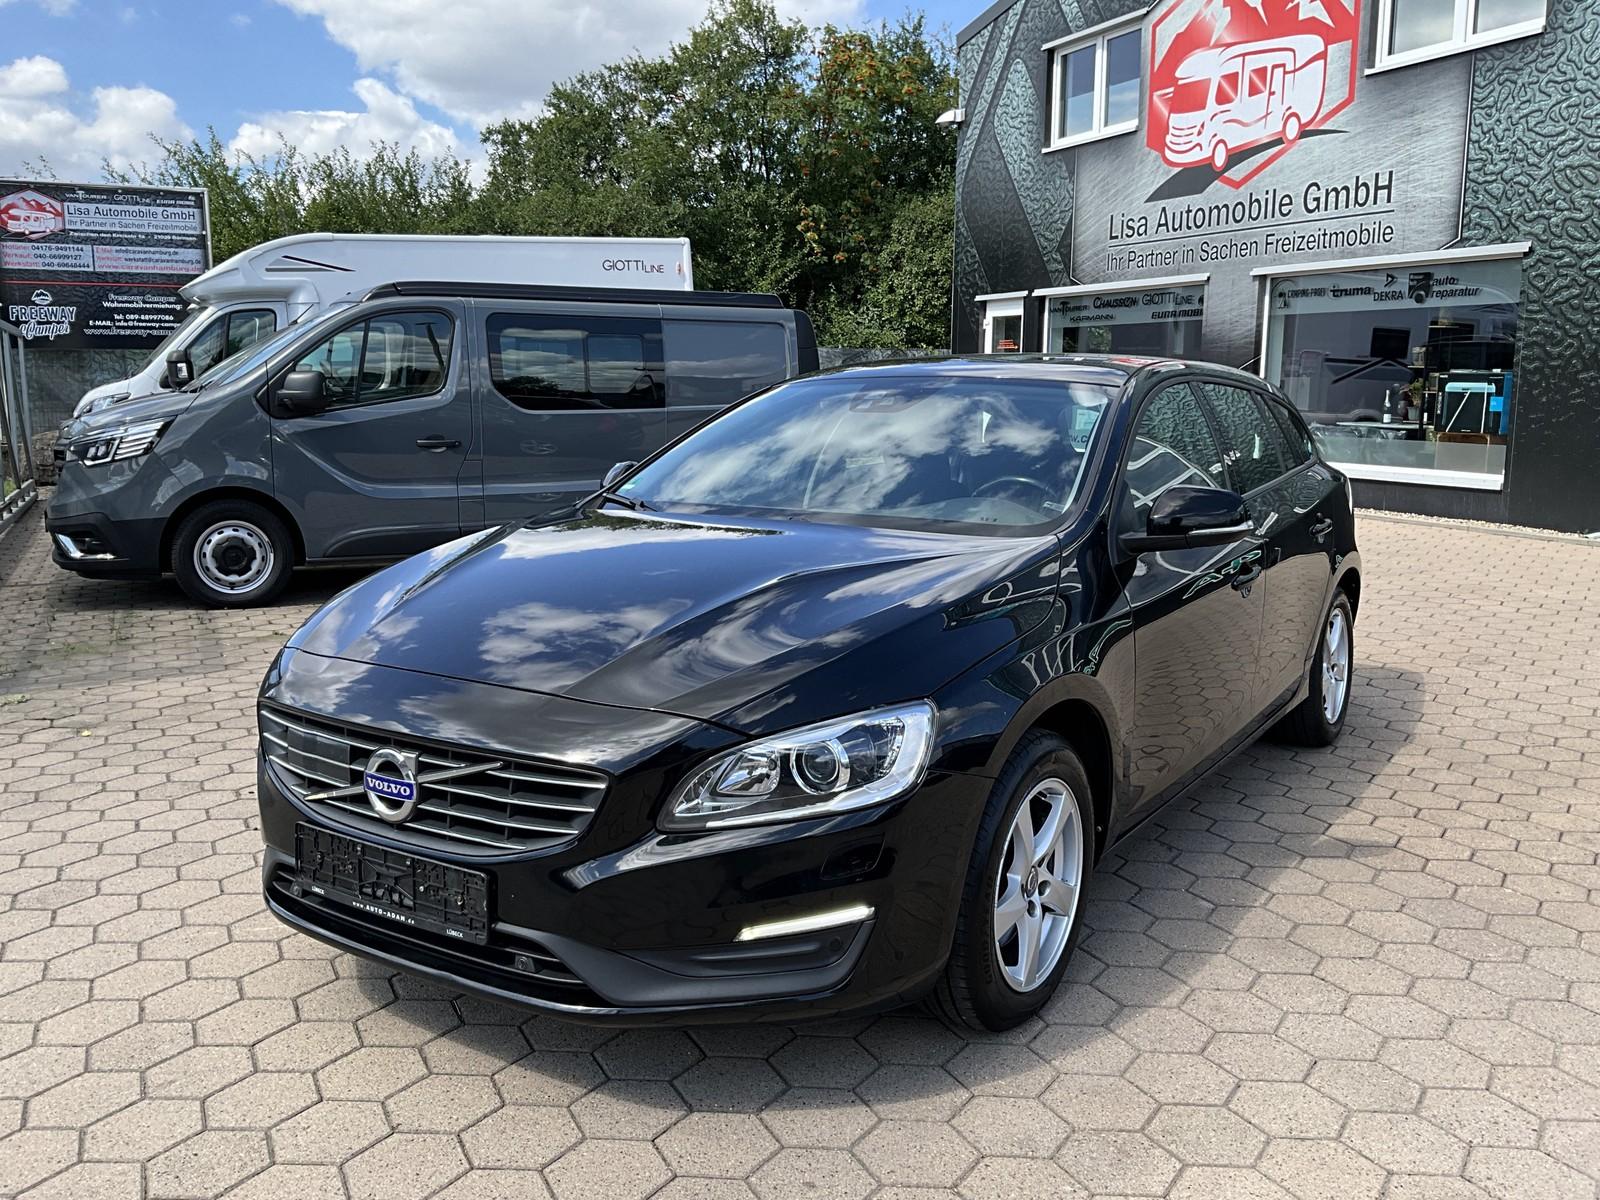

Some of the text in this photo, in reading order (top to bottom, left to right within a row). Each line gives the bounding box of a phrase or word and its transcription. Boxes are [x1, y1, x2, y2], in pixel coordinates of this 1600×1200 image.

[1108, 170, 1395, 241] Lisa Automobile GmbH
[66, 204, 196, 221] Lisa Automobile GmbH
[67, 219, 77, 227] Ihr
[79, 219, 107, 228] Partner
[118, 221, 146, 229] Sachen
[147, 222, 198, 231] Freizeitmobile
[1106, 220, 1395, 272] Ihr Partner in Sachen Freizeitmobile
[1432, 275, 1457, 286] auto
[1330, 286, 1372, 298] truma
[1373, 290, 1404, 302] DEKRA
[1430, 287, 1481, 300] reparatur
[102, 301, 183, 310] Wohnmobilvermietung:
[9, 305, 77, 322] FREEWAY
[19, 319, 70, 341] Camper
[366, 776, 411, 796] VOLVO
[446, 928, 464, 938] LÜBECK
